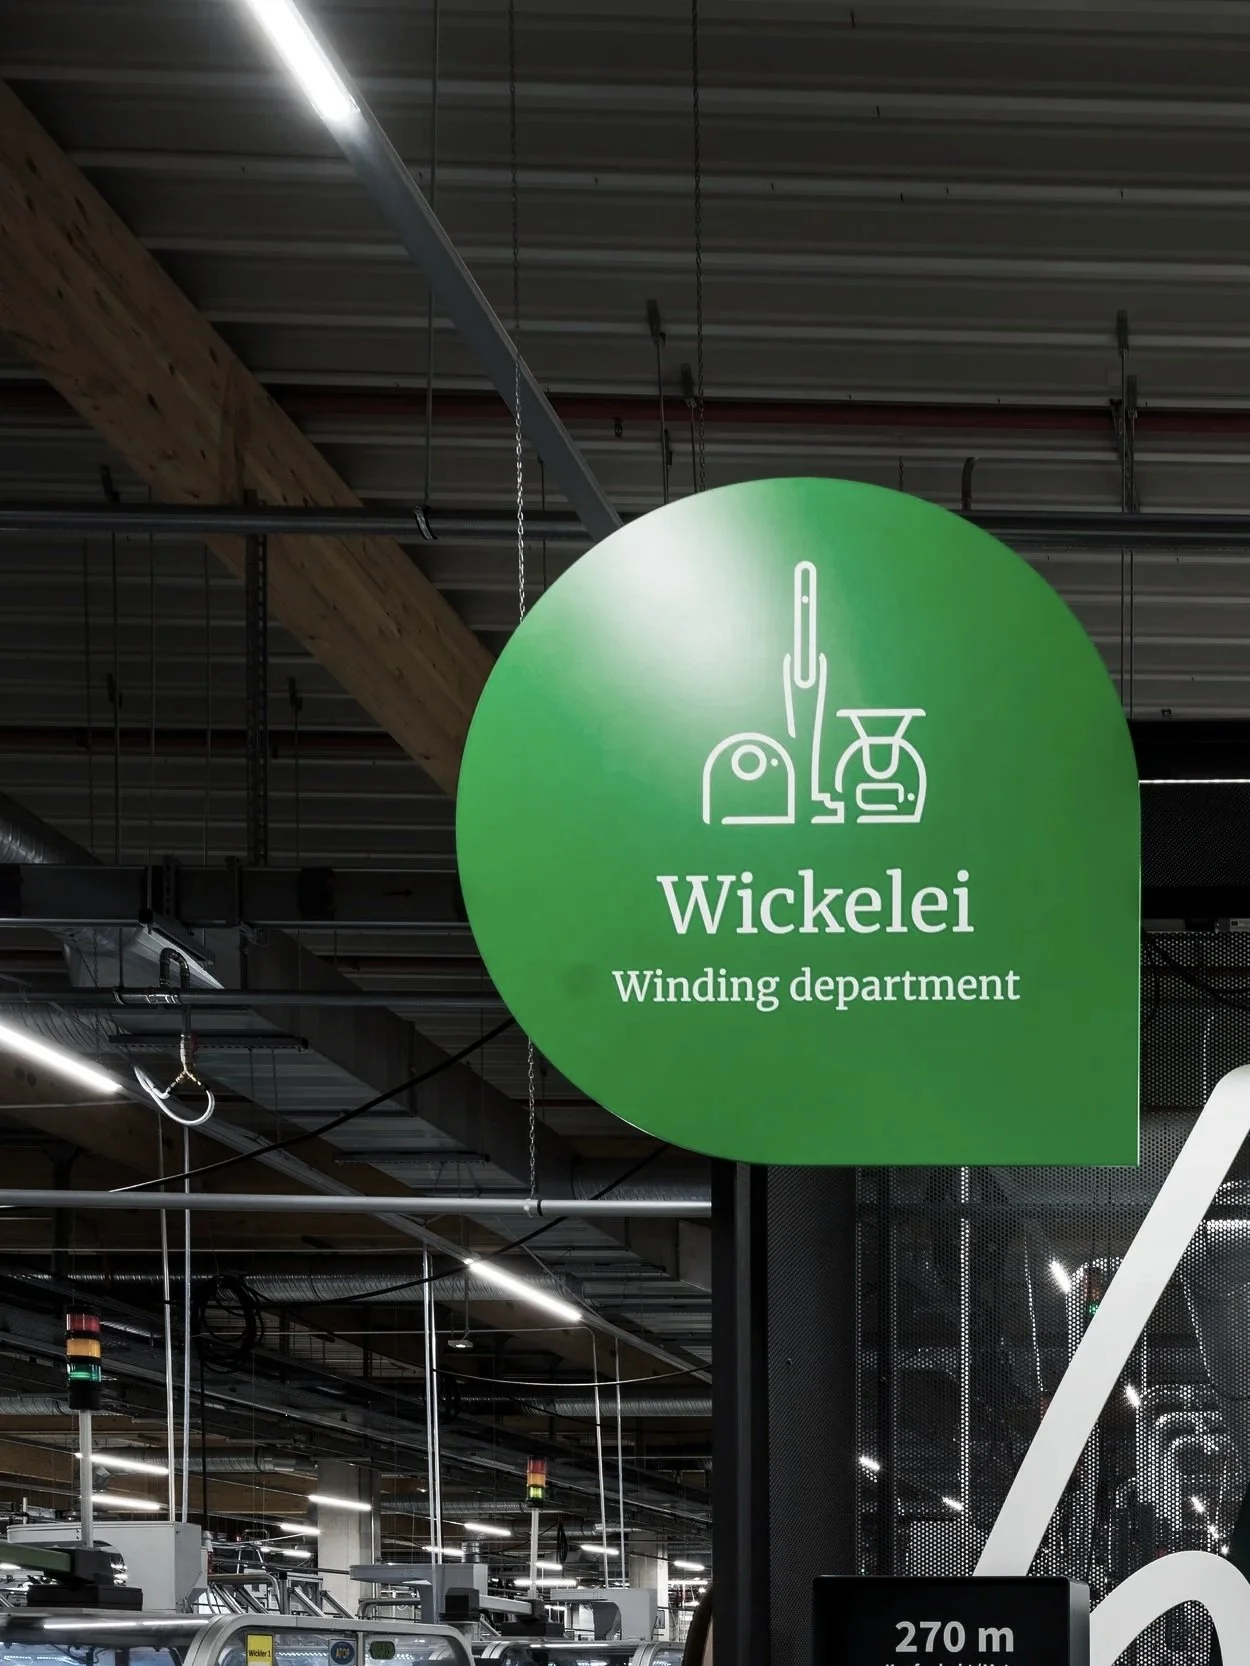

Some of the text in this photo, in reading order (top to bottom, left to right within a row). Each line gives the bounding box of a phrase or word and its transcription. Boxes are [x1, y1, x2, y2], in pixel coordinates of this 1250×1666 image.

[656, 868, 975, 935] Wickelei
[612, 966, 1021, 1012] Winding department
[248, 1648, 267, 1657] Wickler
[895, 1620, 1014, 1653] 270 m
